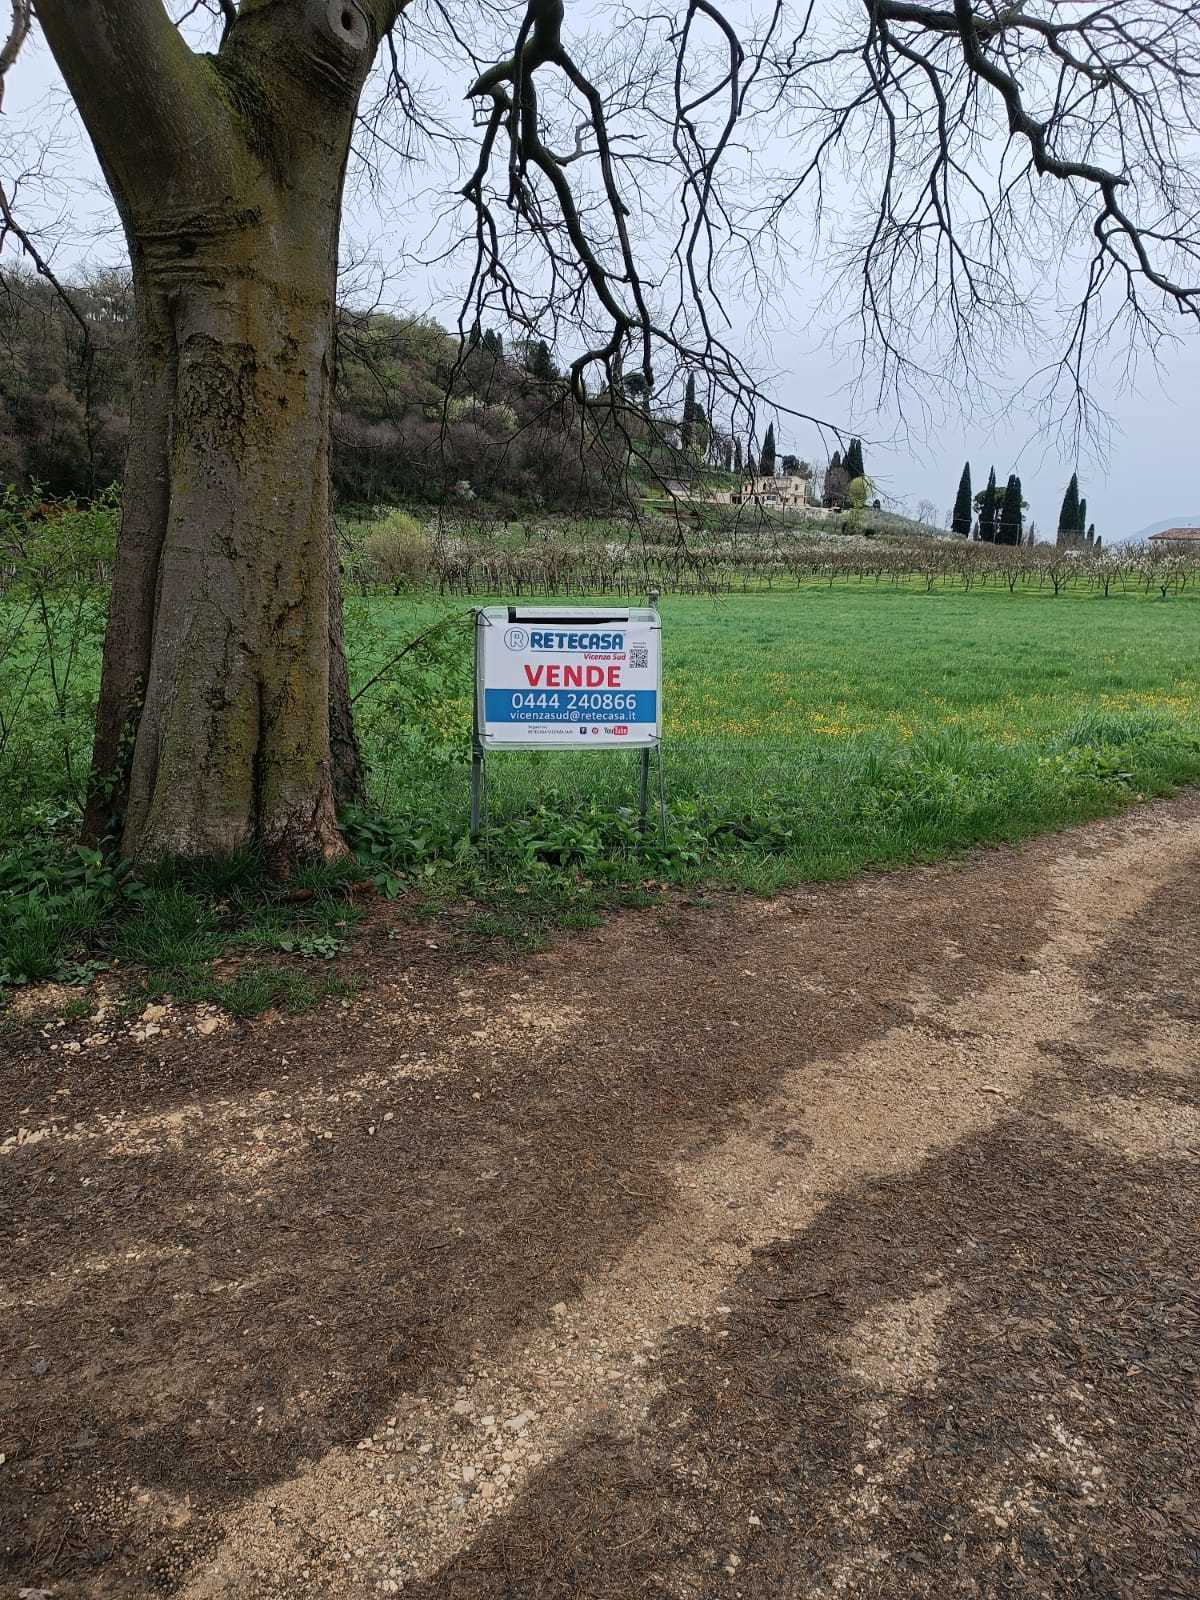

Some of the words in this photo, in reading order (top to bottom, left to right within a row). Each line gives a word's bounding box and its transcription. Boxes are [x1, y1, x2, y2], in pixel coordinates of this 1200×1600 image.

[530, 631, 624, 650] RETECASA
[583, 653, 611, 661] Vicenza
[612, 653, 626, 661] Sud
[523, 664, 622, 688] VENDE
[511, 693, 560, 710] 0444
[566, 693, 637, 711] 240866
[510, 710, 636, 722] vicenzasud@retecasa.it
